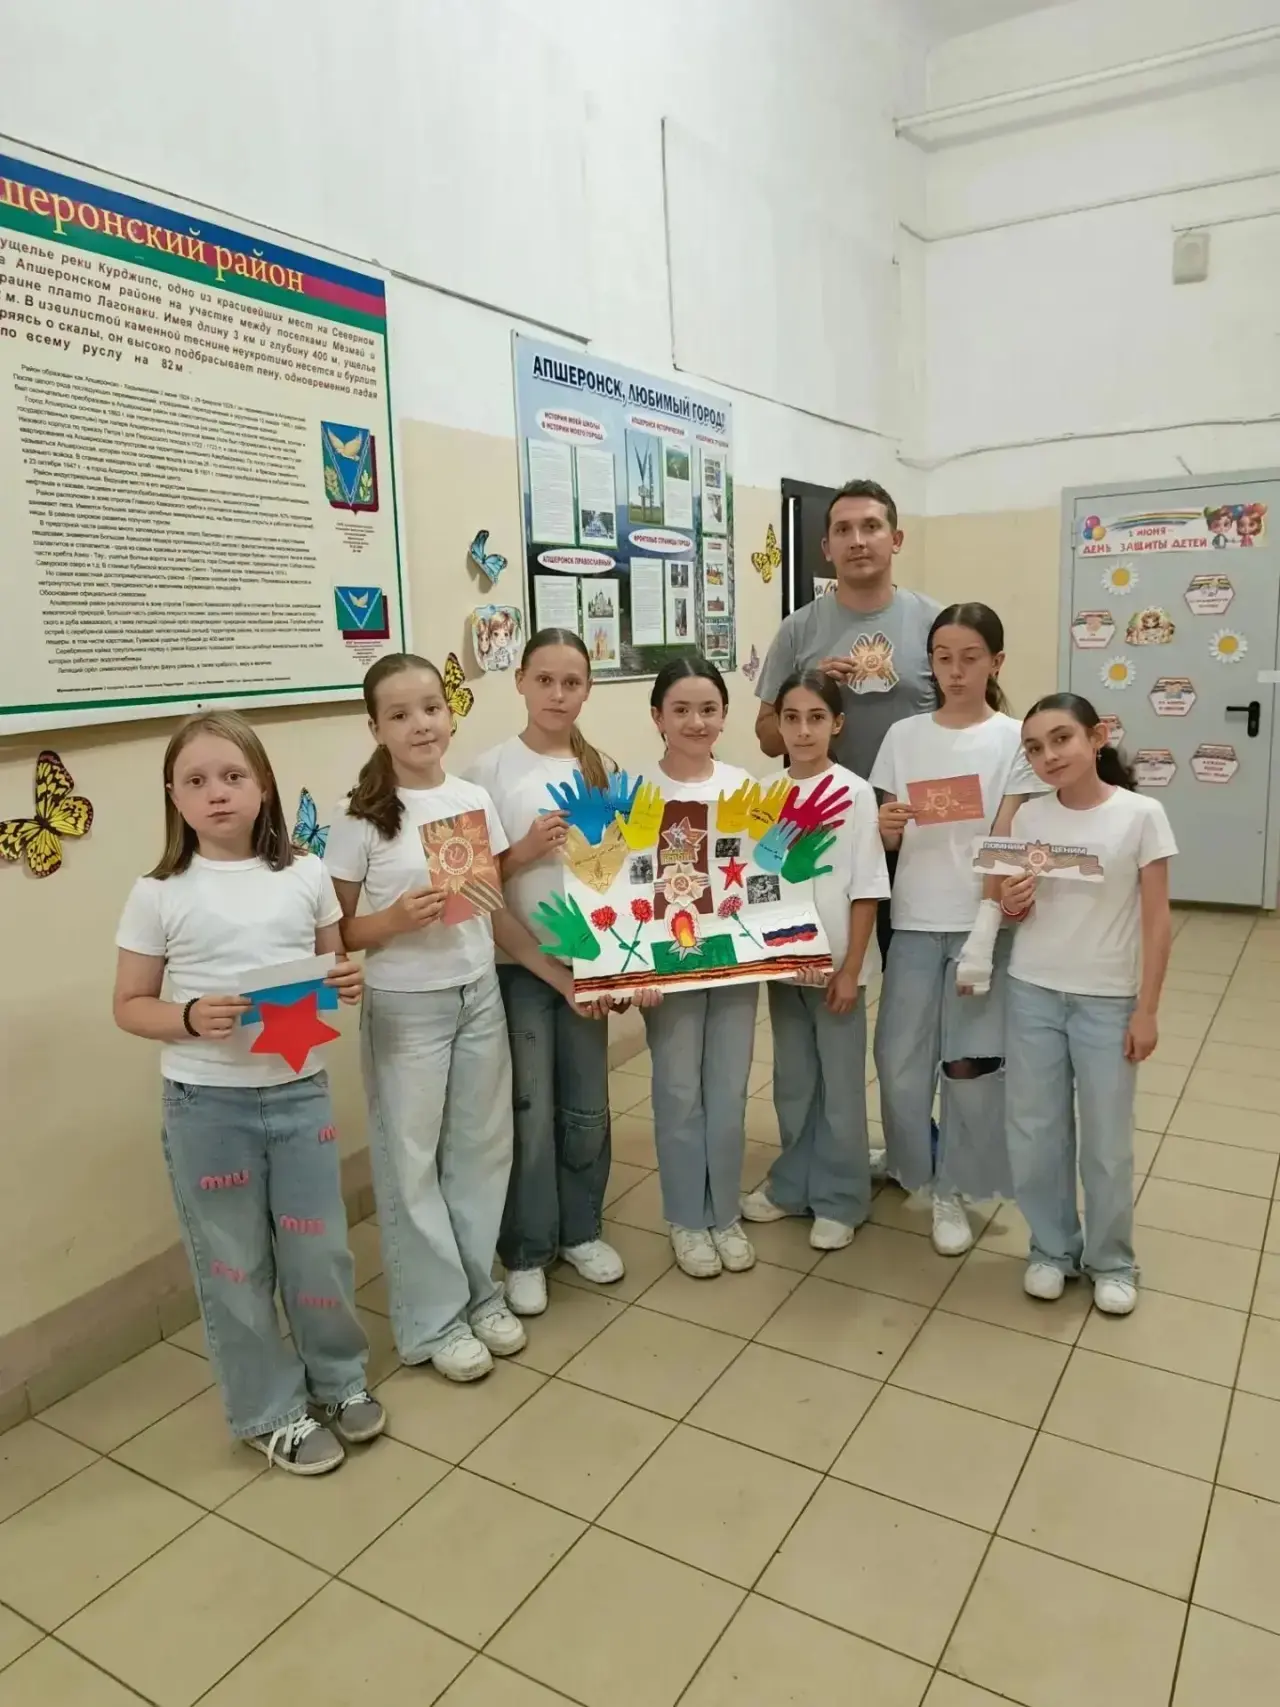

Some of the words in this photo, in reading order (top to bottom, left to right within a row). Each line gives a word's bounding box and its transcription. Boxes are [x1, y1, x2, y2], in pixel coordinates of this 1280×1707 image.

[213, 243, 305, 294] район
[1, 238, 54, 259] ущелье
[61, 255, 92, 269] реки
[98, 263, 162, 289] Курджипс,
[168, 284, 195, 297] одно
[200, 293, 212, 302] из
[217, 298, 283, 321] красивейших
[287, 318, 313, 330] мест
[332, 327, 375, 345] Северном
[16, 258, 111, 290] Апшеронском
[119, 287, 162, 304] районе
[169, 301, 182, 309] на
[188, 306, 234, 323] участке
[240, 320, 271, 335] между
[277, 329, 328, 347] поселками
[332, 341, 365, 356] Мезмай
[0, 274, 41, 290] раине
[48, 286, 92, 302] плато
[97, 295, 158, 318] Лагонаки.
[164, 313, 192, 327] Имея
[197, 321, 229, 339] длину
[233, 330, 239, 340] 3
[243, 335, 255, 343] км
[269, 342, 309, 358] глубину
[312, 351, 328, 361] 400
[343, 360, 376, 372] ущелье
[5, 293, 20, 303] м.
[25, 295, 33, 306] В
[38, 301, 121, 326] извилистой
[124, 321, 180, 340] каменной
[184, 335, 230, 352] теснине
[232, 348, 293, 367] неукротимо
[295, 363, 334, 376] несется
[344, 371, 377, 385] бурлит
[0, 328, 17, 337] по
[26, 333, 71, 350] всему
[82, 344, 123, 361] руслу
[134, 356, 149, 364] на
[0, 309, 41, 325] ряясь
[46, 320, 54, 328] о
[58, 323, 103, 339] скалы,
[108, 333, 123, 343] он
[127, 338, 171, 353] высоко
[174, 348, 253, 372] подбрасывает
[257, 368, 282, 380] пену,
[284, 373, 351, 393] одновременно
[353, 389, 377, 398] падая
[533, 355, 625, 402] АПШЕРОНСК,
[628, 384, 690, 417] ЛЮБИМЫЙ
[692, 403, 726, 427] ГОРОД!
[544, 412, 568, 422] ИСТОРИЯ
[568, 416, 581, 425] МОЕЙ
[546, 423, 569, 433] ИСТОРИИ
[1083, 543, 1112, 554] ДЕНЬ
[1120, 540, 1168, 552] ЗАЩИТЫ
[1171, 538, 1208, 549] ДЕТЕЙ
[1136, 527, 1166, 536] ИЮНЯ
[542, 555, 574, 564] АПШЕРОНСК
[1051, 846, 1086, 854] ЦЕНИМ
